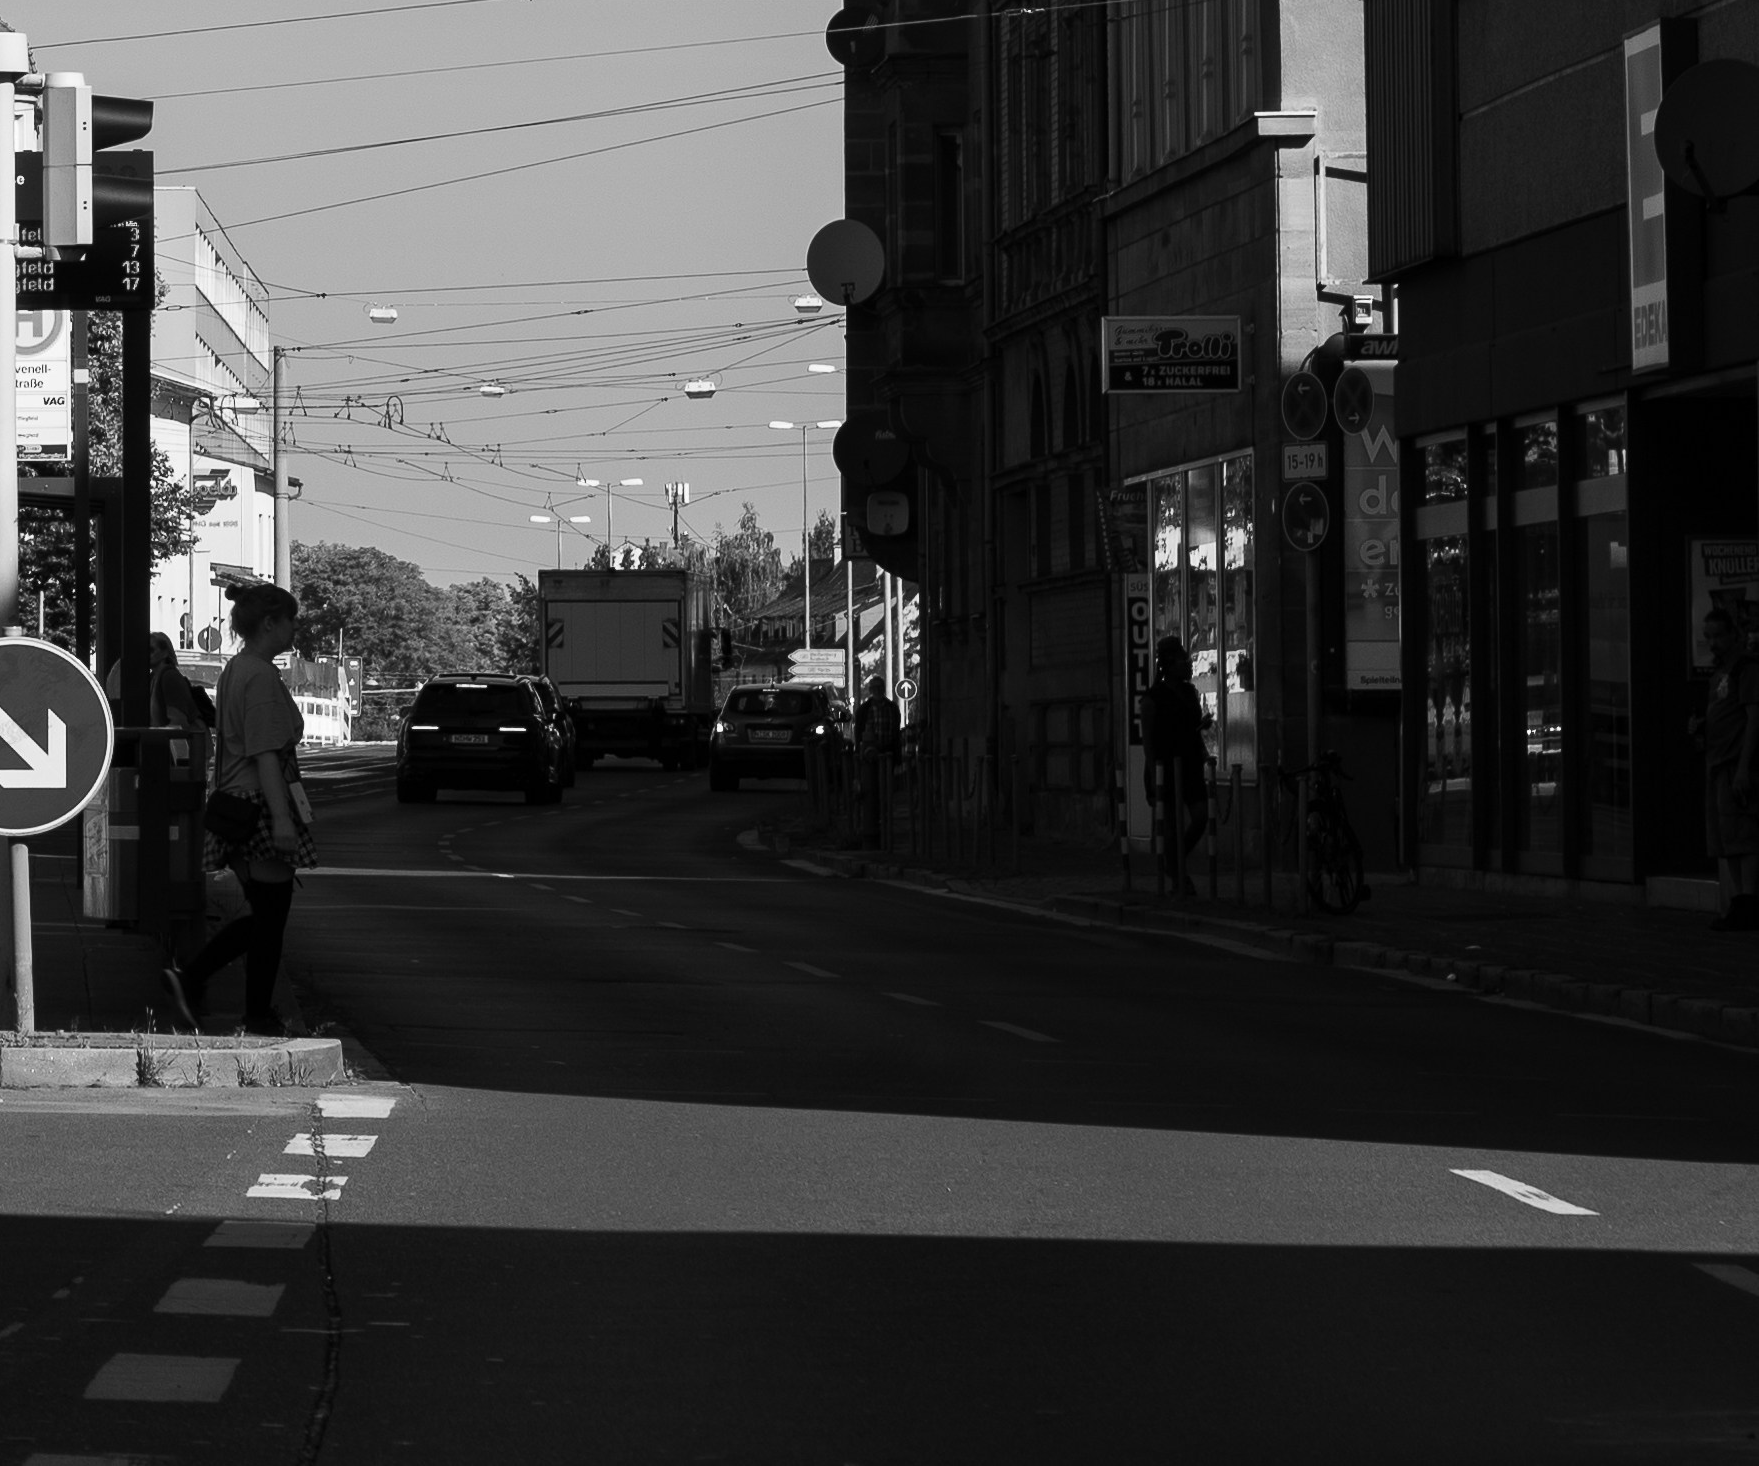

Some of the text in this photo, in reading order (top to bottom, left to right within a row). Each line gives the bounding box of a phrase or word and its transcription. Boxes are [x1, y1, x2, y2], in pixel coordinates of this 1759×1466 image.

[130, 227, 140, 241] 3
[130, 244, 140, 258] 7
[122, 260, 140, 274] 13
[122, 277, 140, 291] 17
[1634, 300, 1666, 350] EDEKA
[1152, 328, 1234, 358] Trolli
[15, 364, 52, 375] venell-
[1158, 365, 1231, 376] ZUCKERFREI
[15, 379, 44, 389] traße
[1166, 376, 1203, 387] HALAL
[43, 396, 66, 406] VAG
[1287, 453, 1323, 470] 15-19 h
[1360, 675, 1402, 686] Spielteiln
